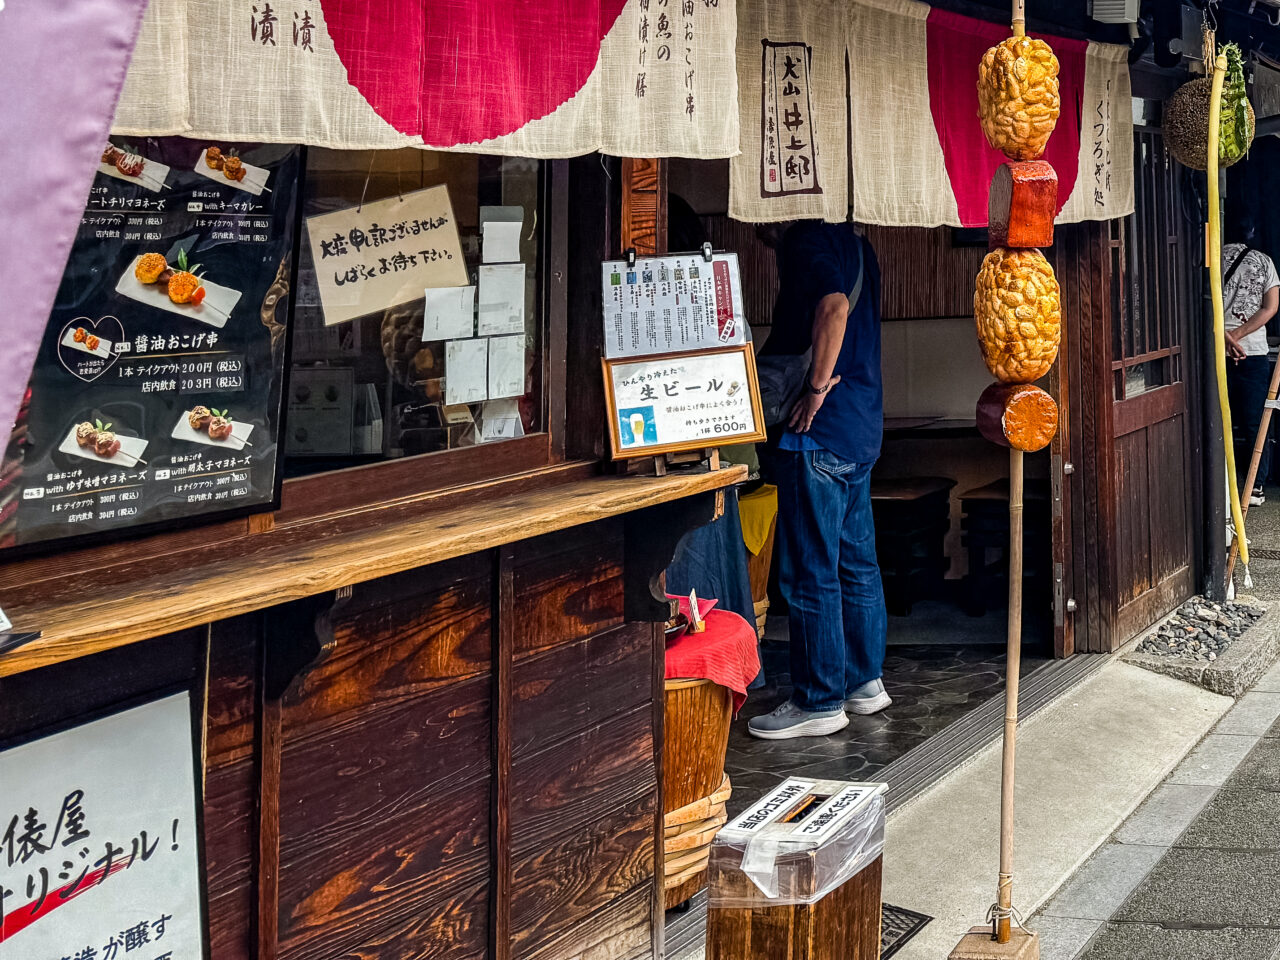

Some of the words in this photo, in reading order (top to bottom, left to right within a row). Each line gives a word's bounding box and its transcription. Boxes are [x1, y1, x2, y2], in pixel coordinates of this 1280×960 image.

[782, 56, 810, 183] 犬山井上邸
[1093, 100, 1105, 207] くつろぎ処
[86, 198, 166, 209] ートチリマヨネーズ
[219, 201, 263, 211] キーマカレー
[95, 230, 120, 238] 店内飲食
[134, 331, 219, 353] 醤油おこげ串
[119, 367, 134, 378] 1本
[137, 364, 180, 376] テイクアウト
[182, 362, 213, 374] 200円
[216, 360, 242, 372] (税込)
[141, 380, 176, 392] 店内飲食
[181, 377, 213, 389] 203円
[216, 376, 242, 388] (税込)
[640, 378, 723, 401] 生ビール
[714, 422, 747, 433] 600円
[171, 467, 187, 476] with
[45, 485, 64, 494] with
[66, 470, 148, 491] ゆず味噌マヨネーズ
[182, 481, 214, 492] テイクアウト
[187, 492, 212, 503] 店内飲食
[63, 499, 94, 511] テイクアウト
[68, 512, 93, 523] 店内飲食
